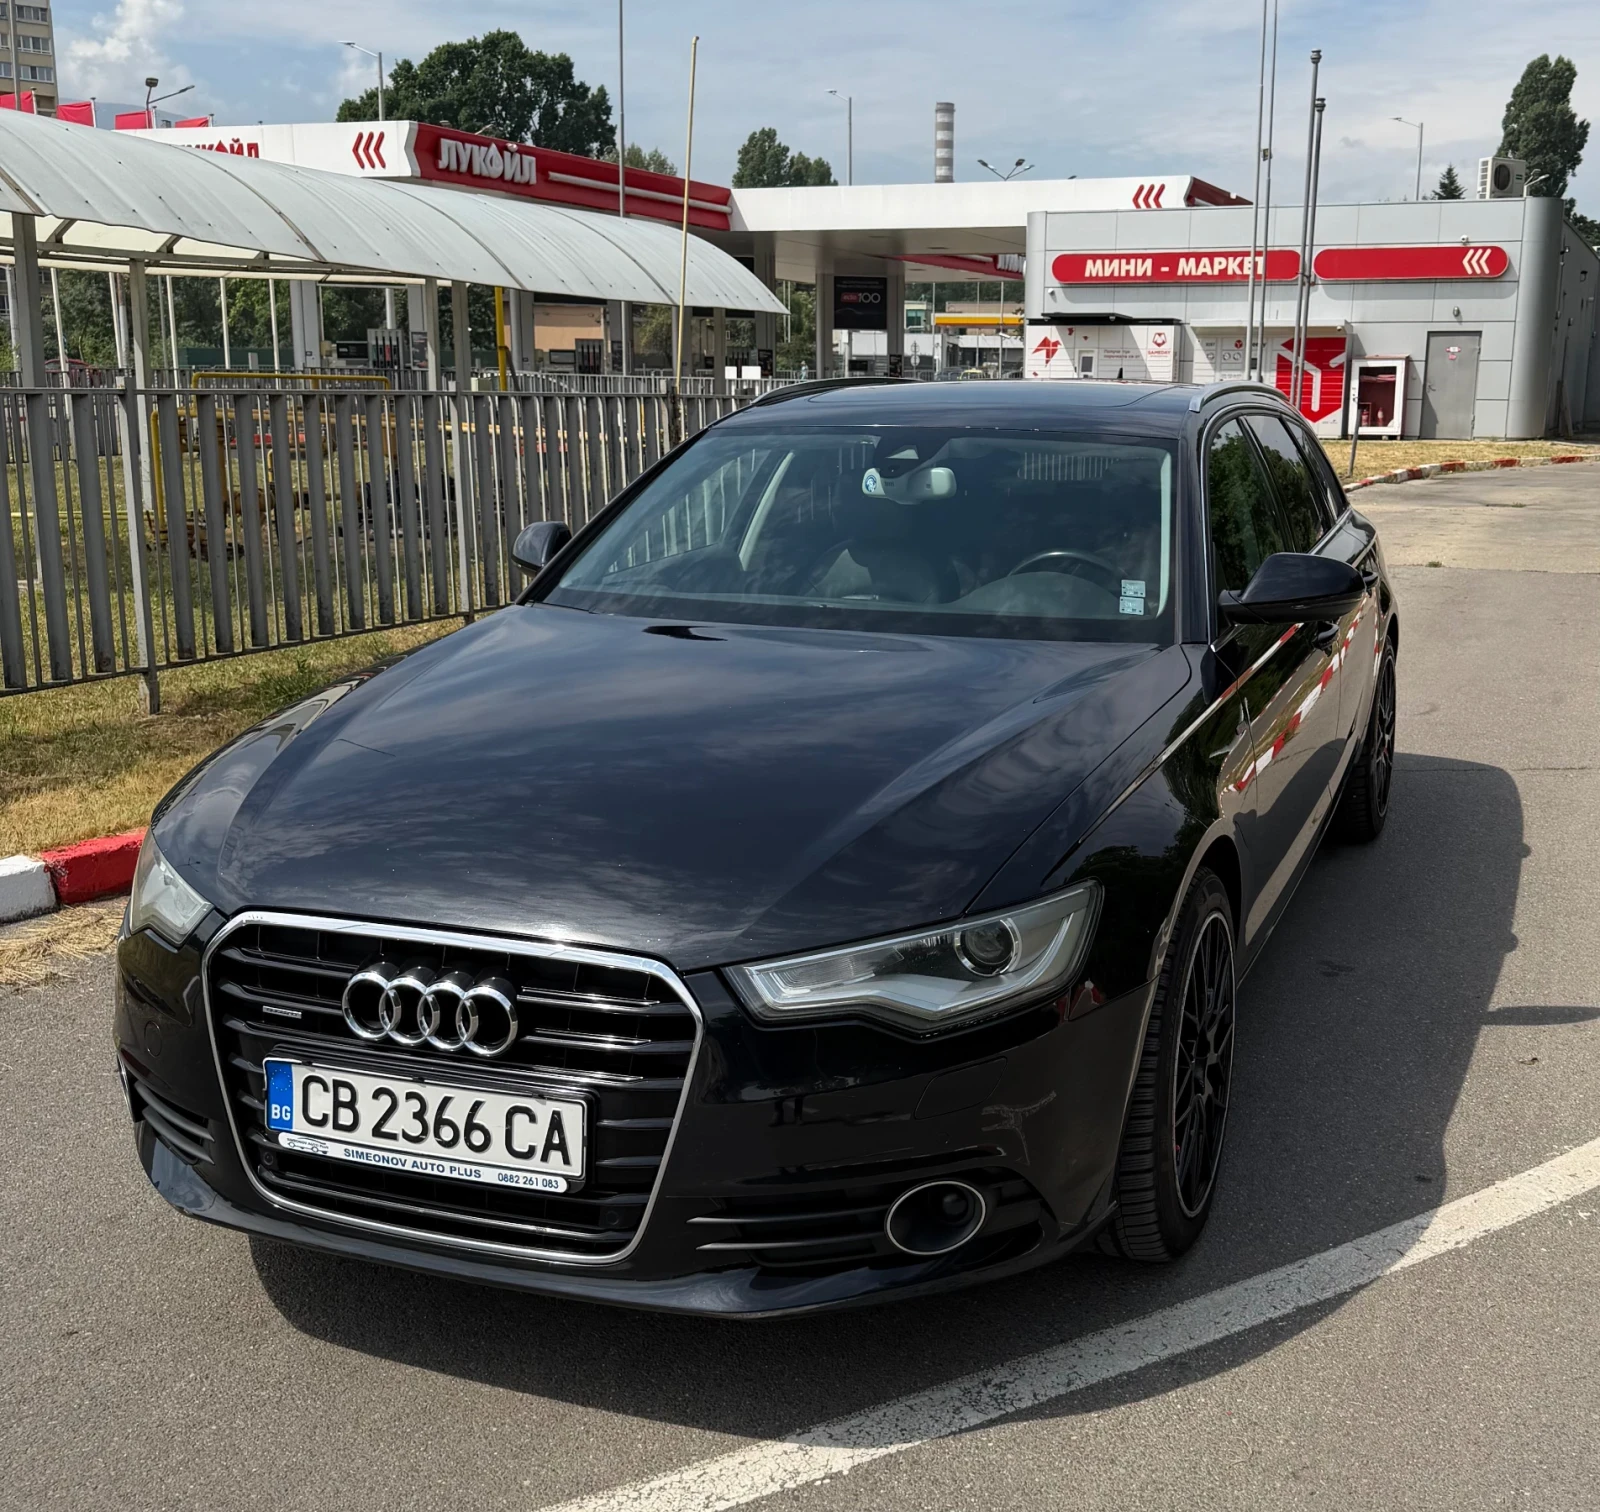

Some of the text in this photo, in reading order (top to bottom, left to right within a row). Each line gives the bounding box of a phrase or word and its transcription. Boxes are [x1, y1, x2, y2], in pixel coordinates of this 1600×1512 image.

[438, 138, 537, 185] ЛУКОЙЛ
[1084, 258, 1153, 277] МИНИ
[1177, 256, 1266, 276] МАРКЕТ
[271, 1104, 291, 1121] BG
[302, 1074, 572, 1166] CB 2366 CA
[343, 1148, 559, 1189] SIMEONOV AUTO PLUS 0882 261 083
